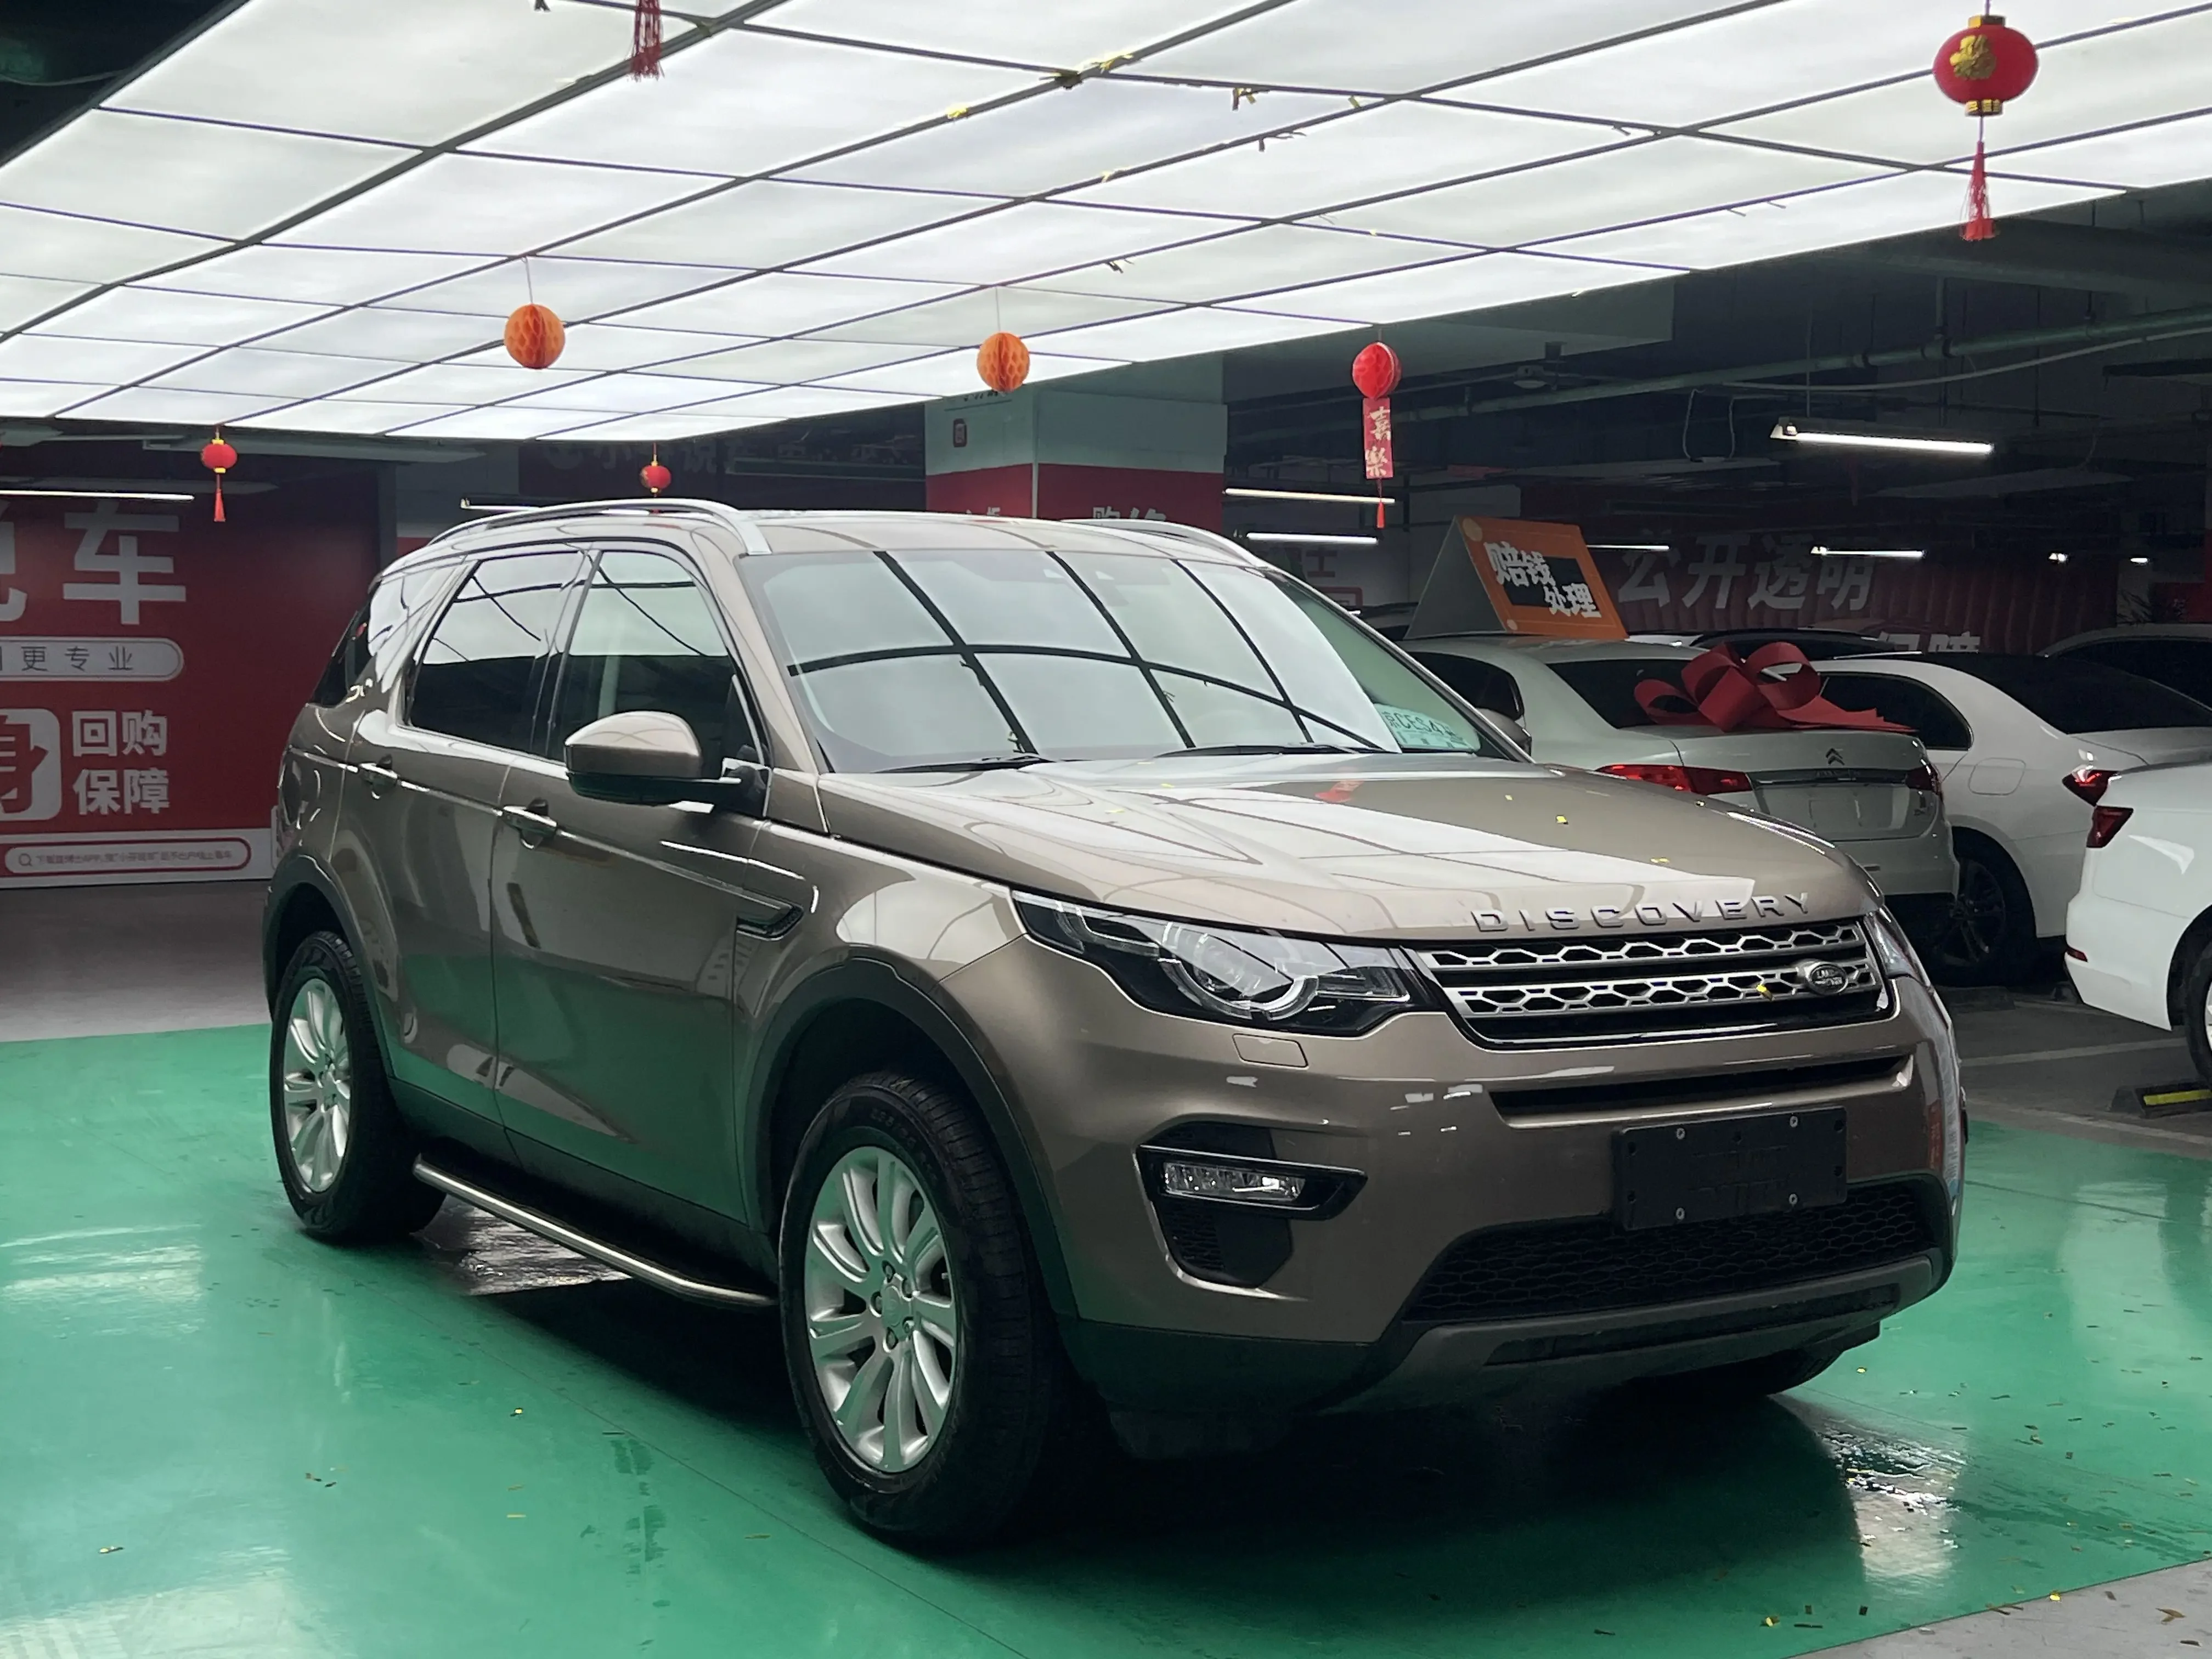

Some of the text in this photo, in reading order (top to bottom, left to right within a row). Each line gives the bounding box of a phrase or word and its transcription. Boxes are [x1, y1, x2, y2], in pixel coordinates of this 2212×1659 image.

[1483, 541, 1556, 587] 赔钱
[1618, 528, 1880, 611] 公开透明
[1543, 583, 1602, 618] 处理
[0, 646, 134, 673] 更专业
[72, 710, 168, 757] 回购
[72, 768, 170, 815] 保障
[1471, 892, 1809, 932] DISCOVERY
